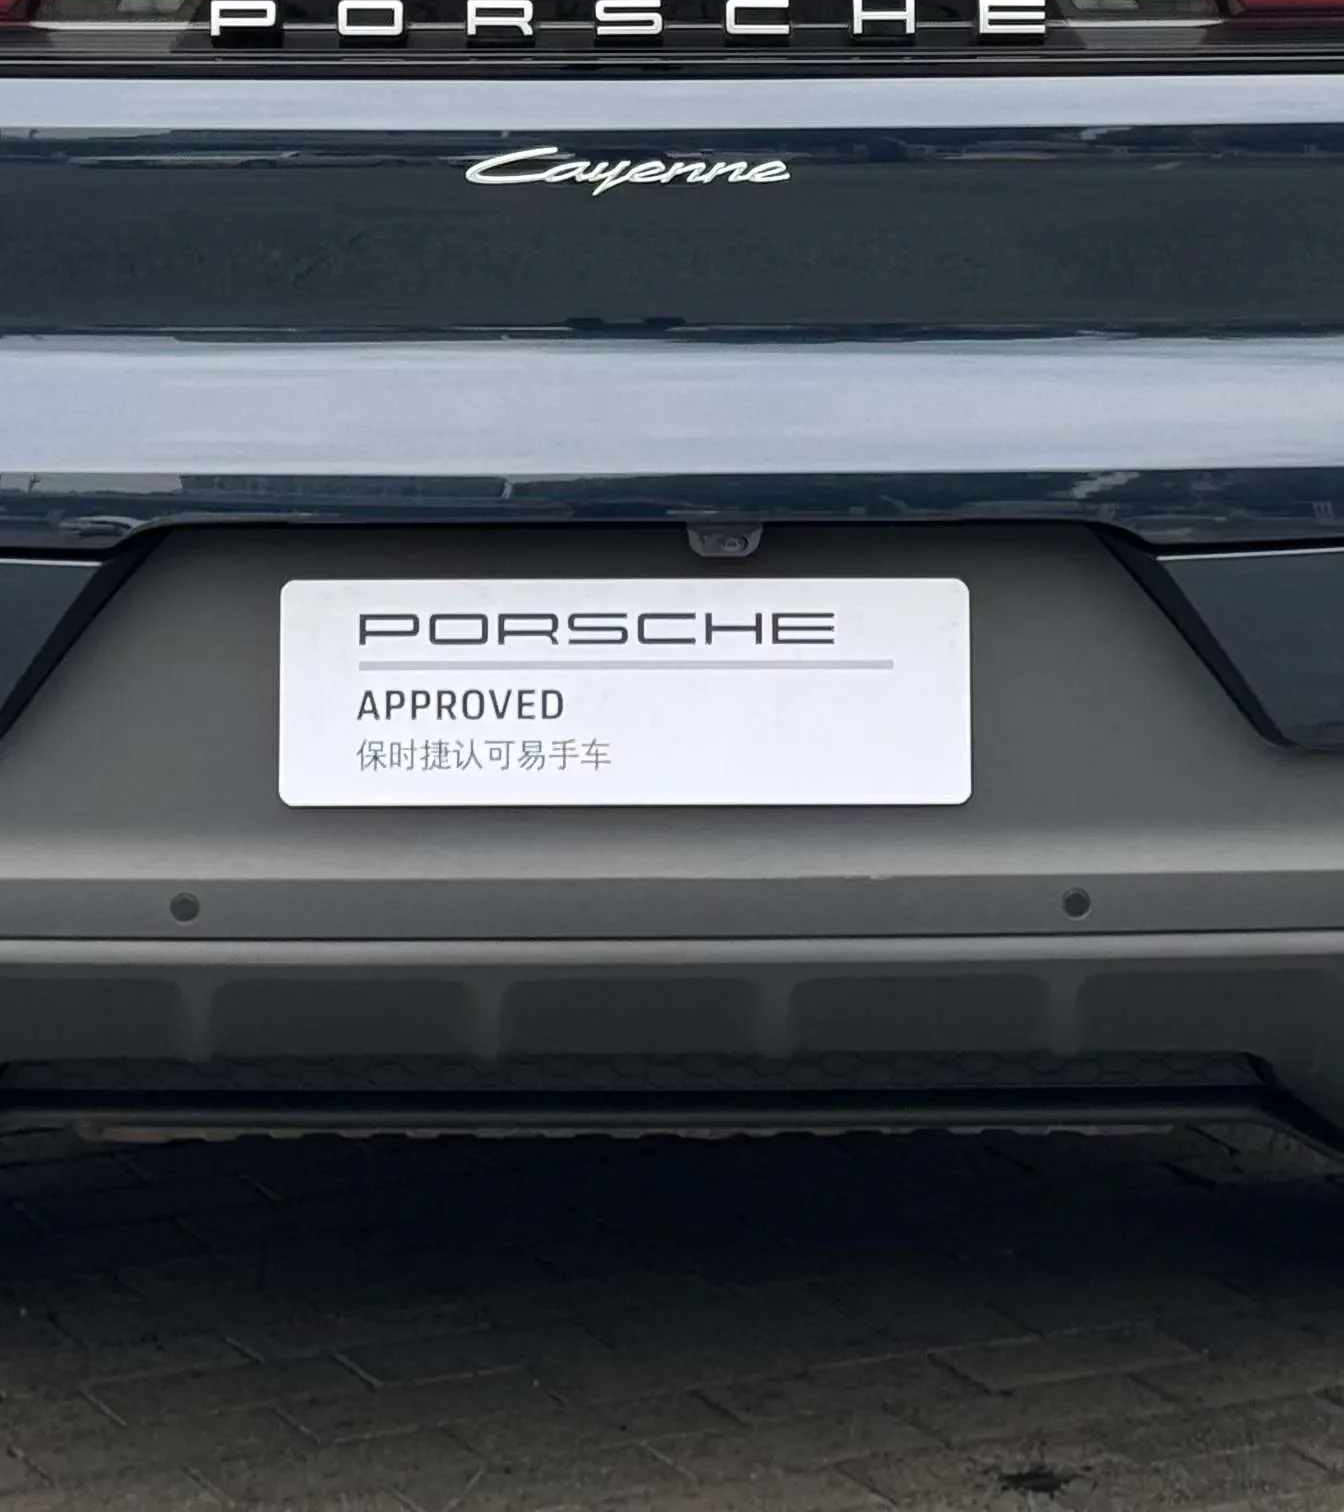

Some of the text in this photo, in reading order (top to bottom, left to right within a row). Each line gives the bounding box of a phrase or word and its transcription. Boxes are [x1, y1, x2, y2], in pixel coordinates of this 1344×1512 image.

[465, 146, 791, 196] Cayenne
[358, 612, 835, 646] PORSCHE
[356, 689, 565, 721] APPROVED
[355, 738, 611, 771] 保时捷认可易手车
